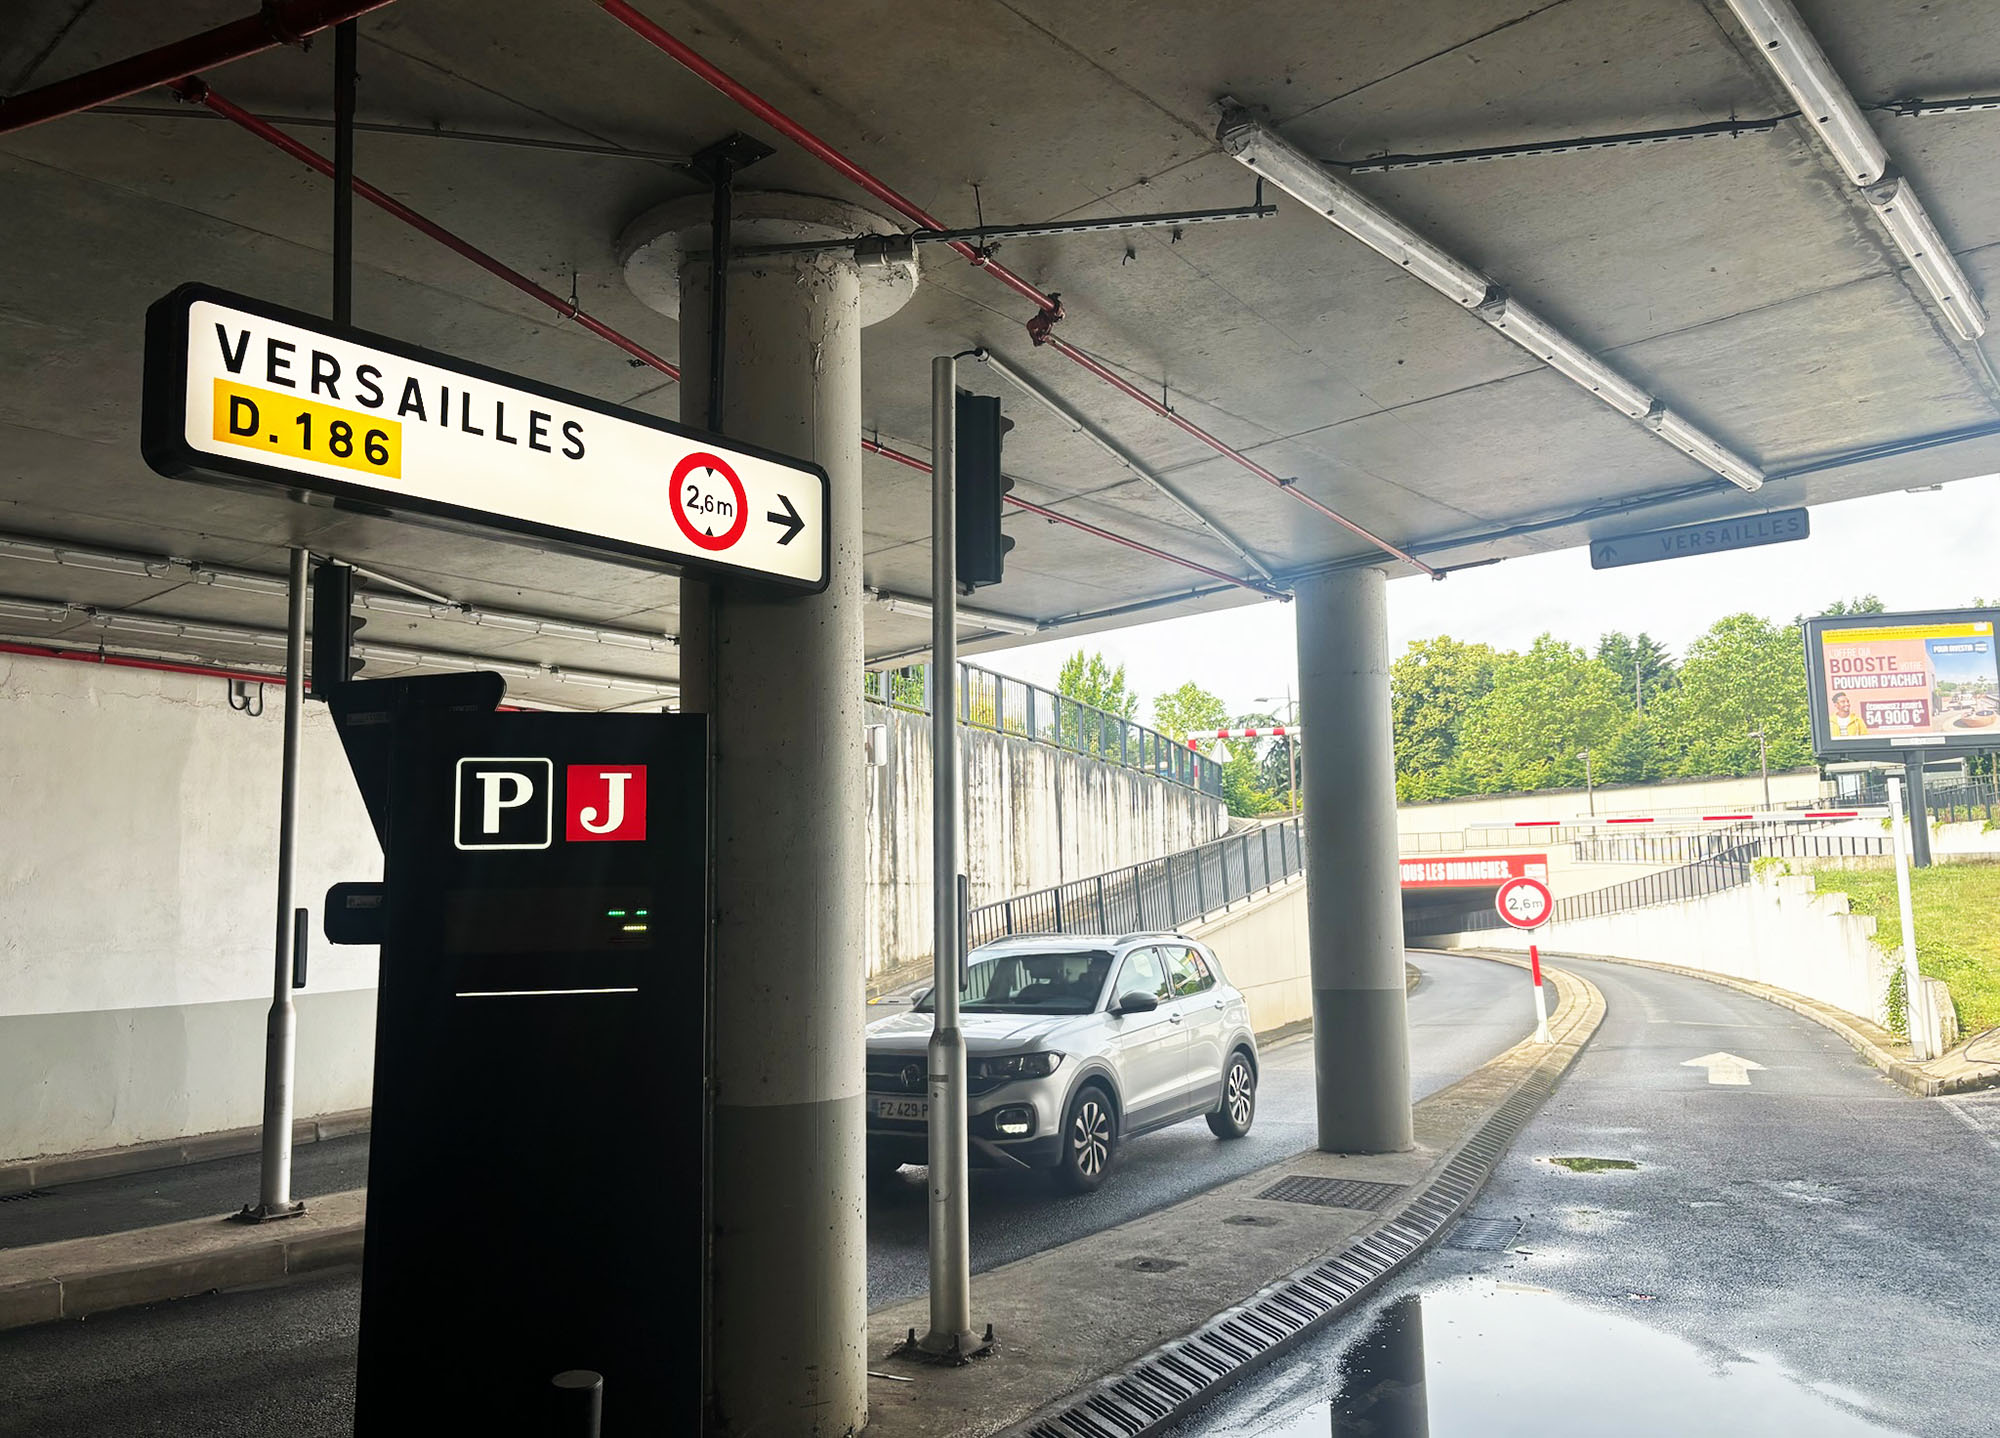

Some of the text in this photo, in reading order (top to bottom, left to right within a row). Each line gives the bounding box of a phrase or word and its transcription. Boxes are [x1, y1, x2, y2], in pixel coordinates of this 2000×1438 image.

[214, 323, 585, 460] VERSAILLES
[229, 396, 390, 466] D.186
[1661, 517, 1799, 552] VERSAILLES
[1830, 656, 1897, 673] BOOSTE
[1834, 674, 1924, 690] POUVOIR D'ACHAT
[1866, 710, 1883, 725] 54
[1885, 710, 1910, 724] 900
[475, 771, 632, 834] P J
[1426, 863, 1445, 881] LES
